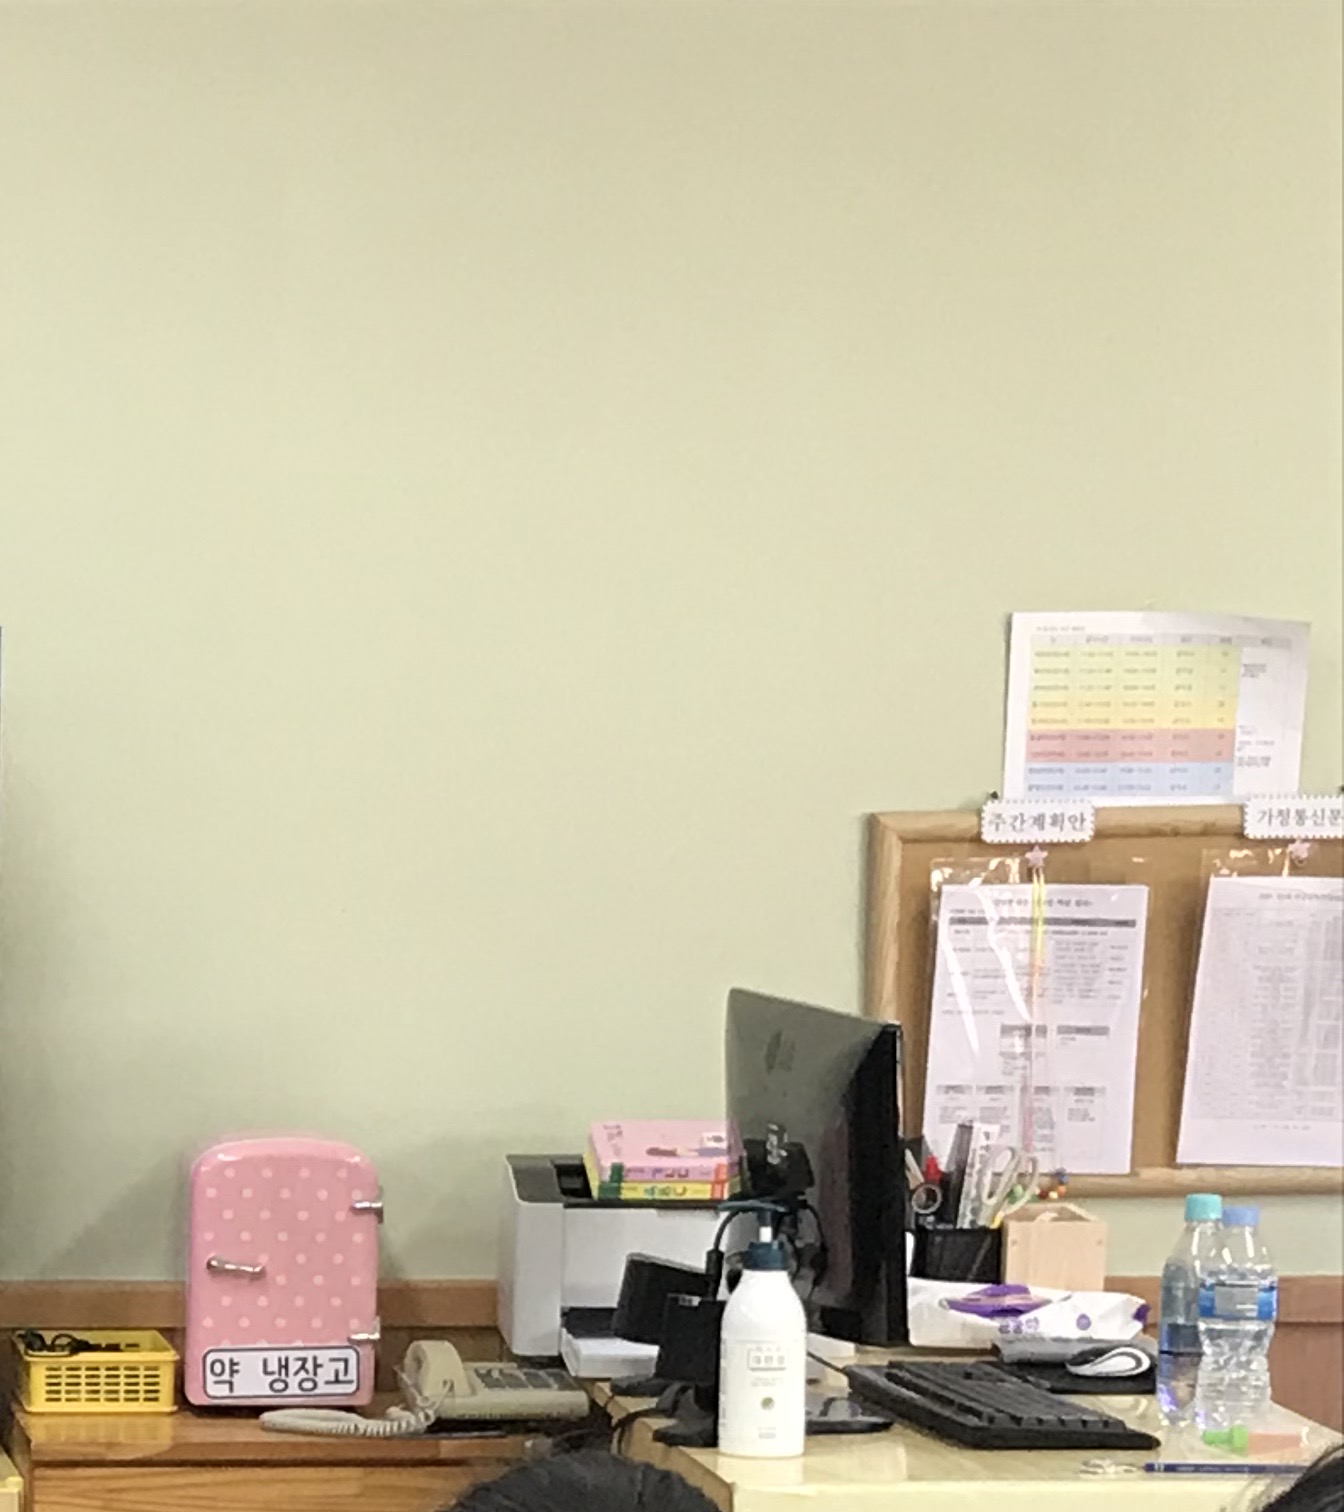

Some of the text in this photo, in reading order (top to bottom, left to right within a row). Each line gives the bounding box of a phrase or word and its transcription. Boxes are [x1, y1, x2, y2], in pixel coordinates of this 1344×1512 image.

[987, 811, 1086, 833] 주간계획안
[209, 1355, 355, 1394] 약 냉장고
